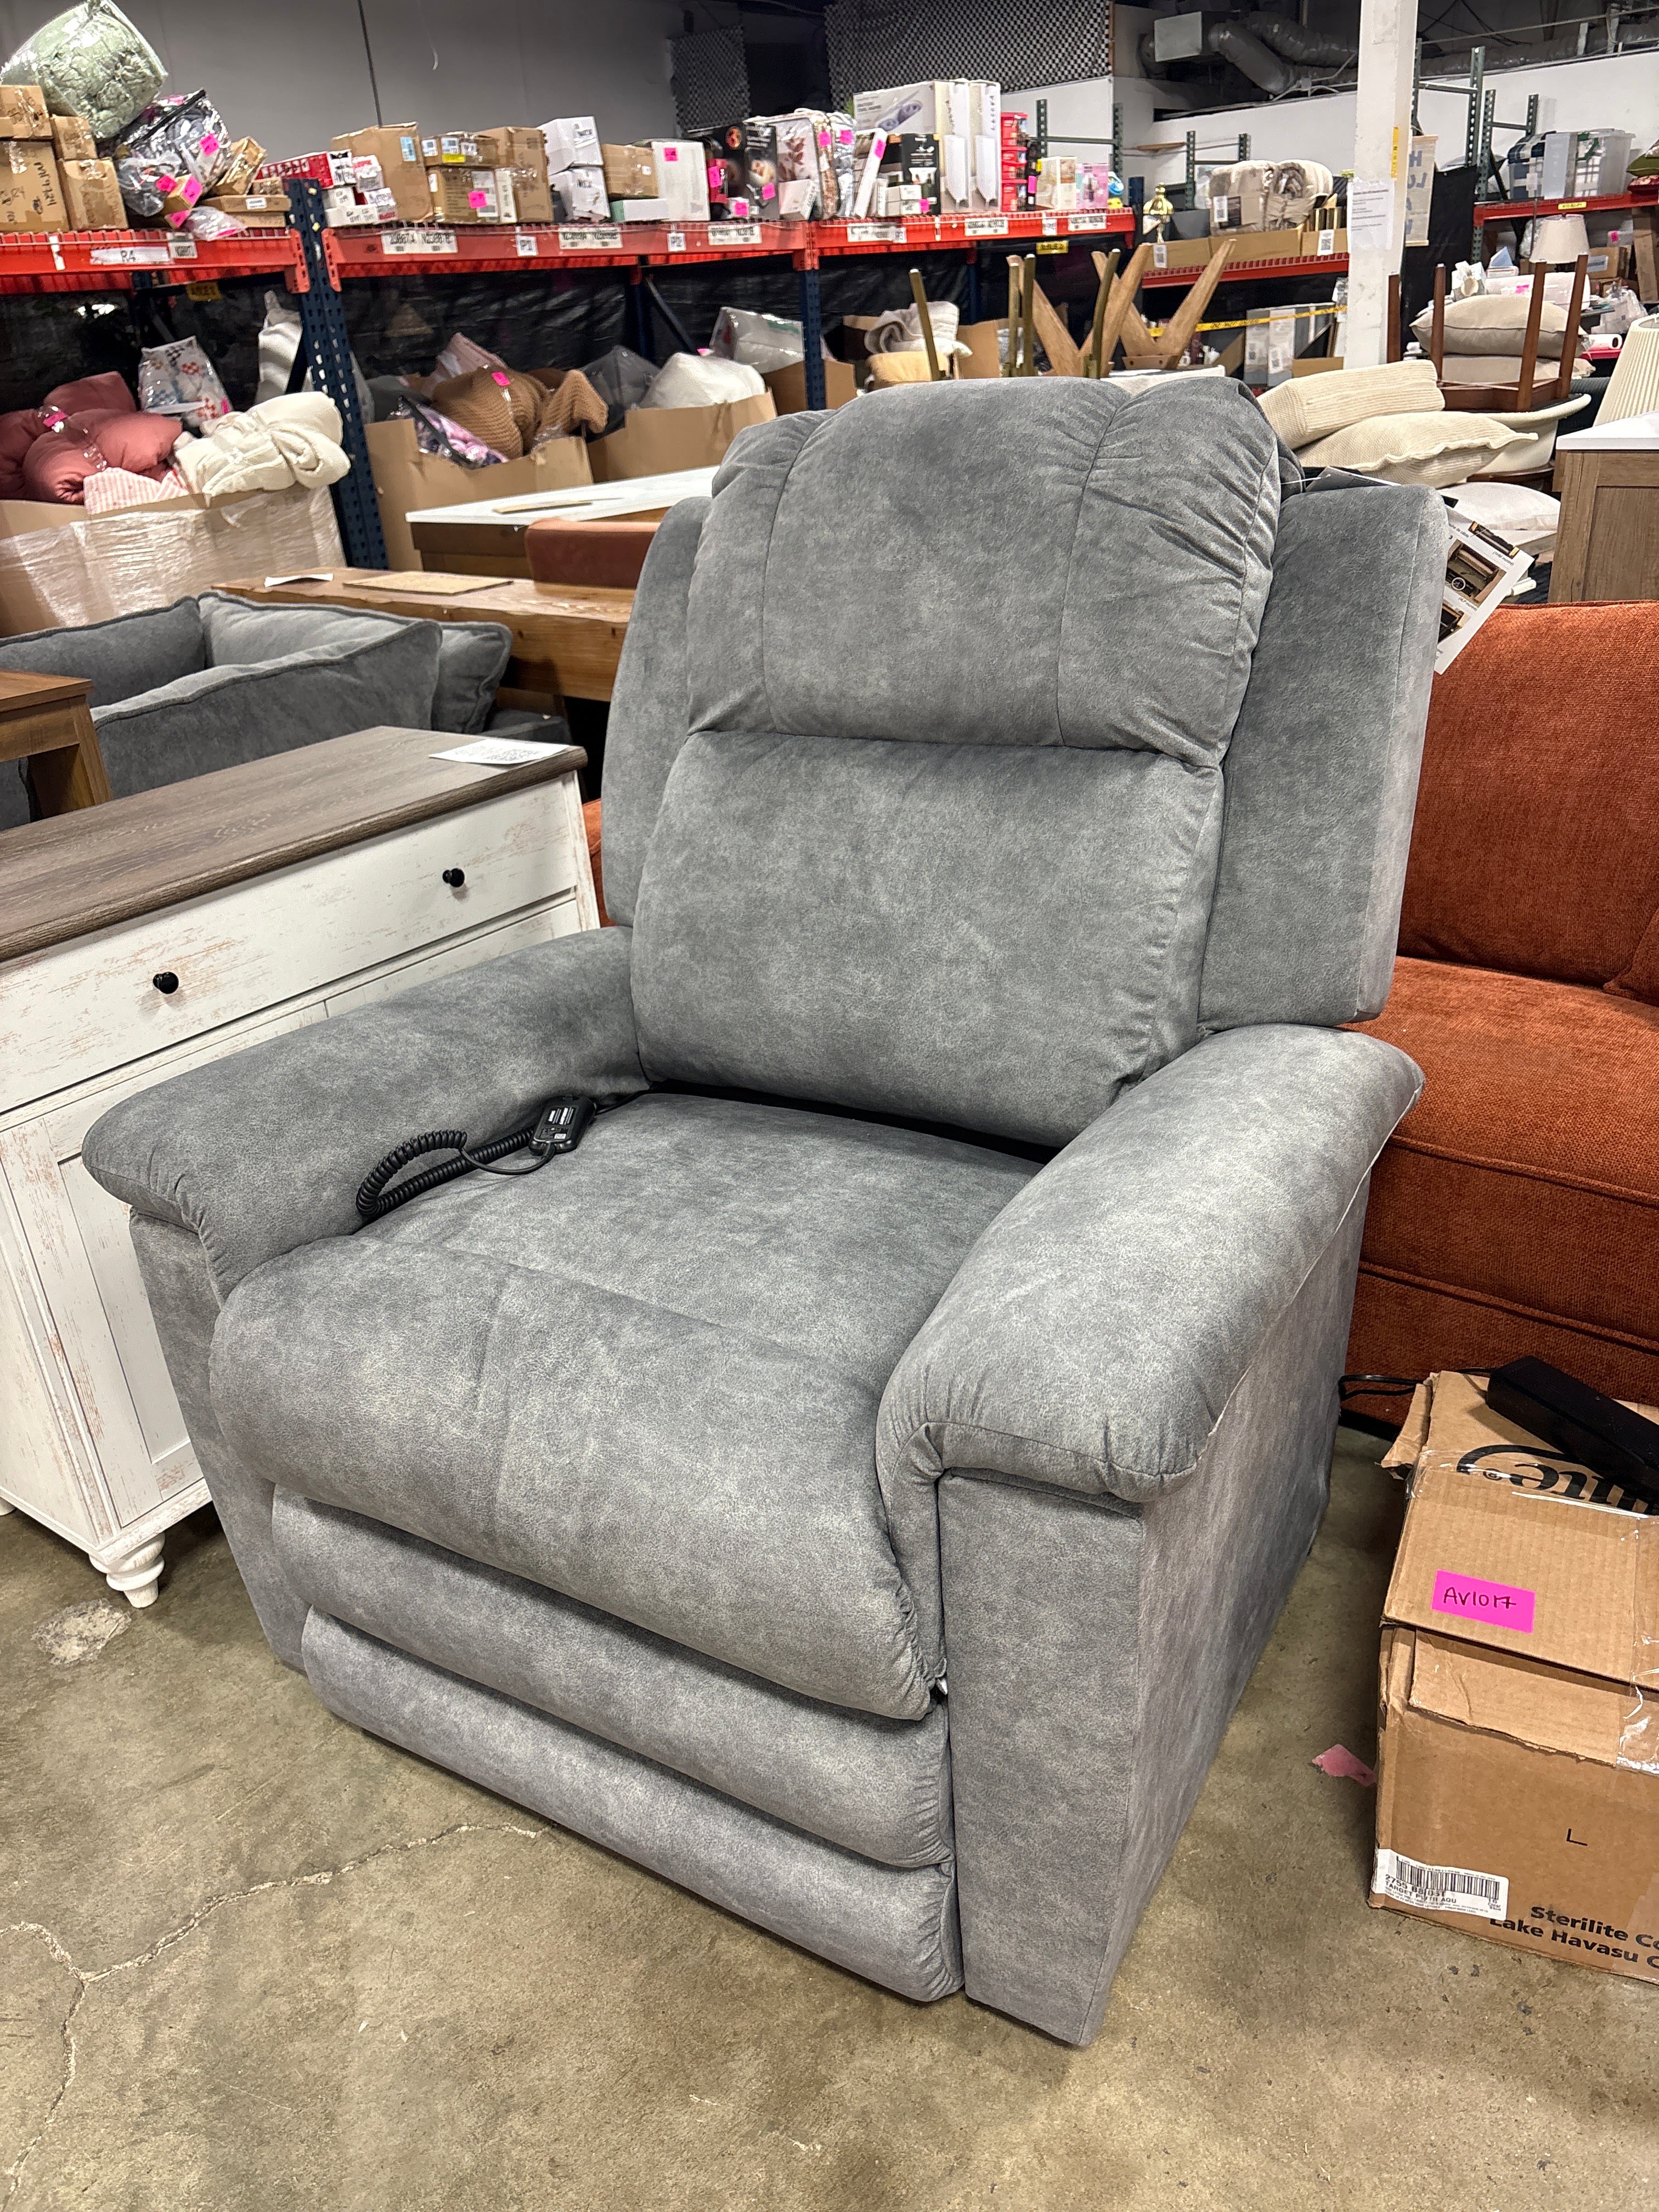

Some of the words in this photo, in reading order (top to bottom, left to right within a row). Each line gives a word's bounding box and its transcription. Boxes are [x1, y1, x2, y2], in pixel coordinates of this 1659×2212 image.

[1443, 1586, 1517, 1609] AV1017
[1385, 1874, 1408, 1889] 2755
[1531, 1906, 1629, 1942] Sterilite
[1489, 1918, 1544, 1938] Lake
[1551, 1929, 1639, 1963] Havasu
